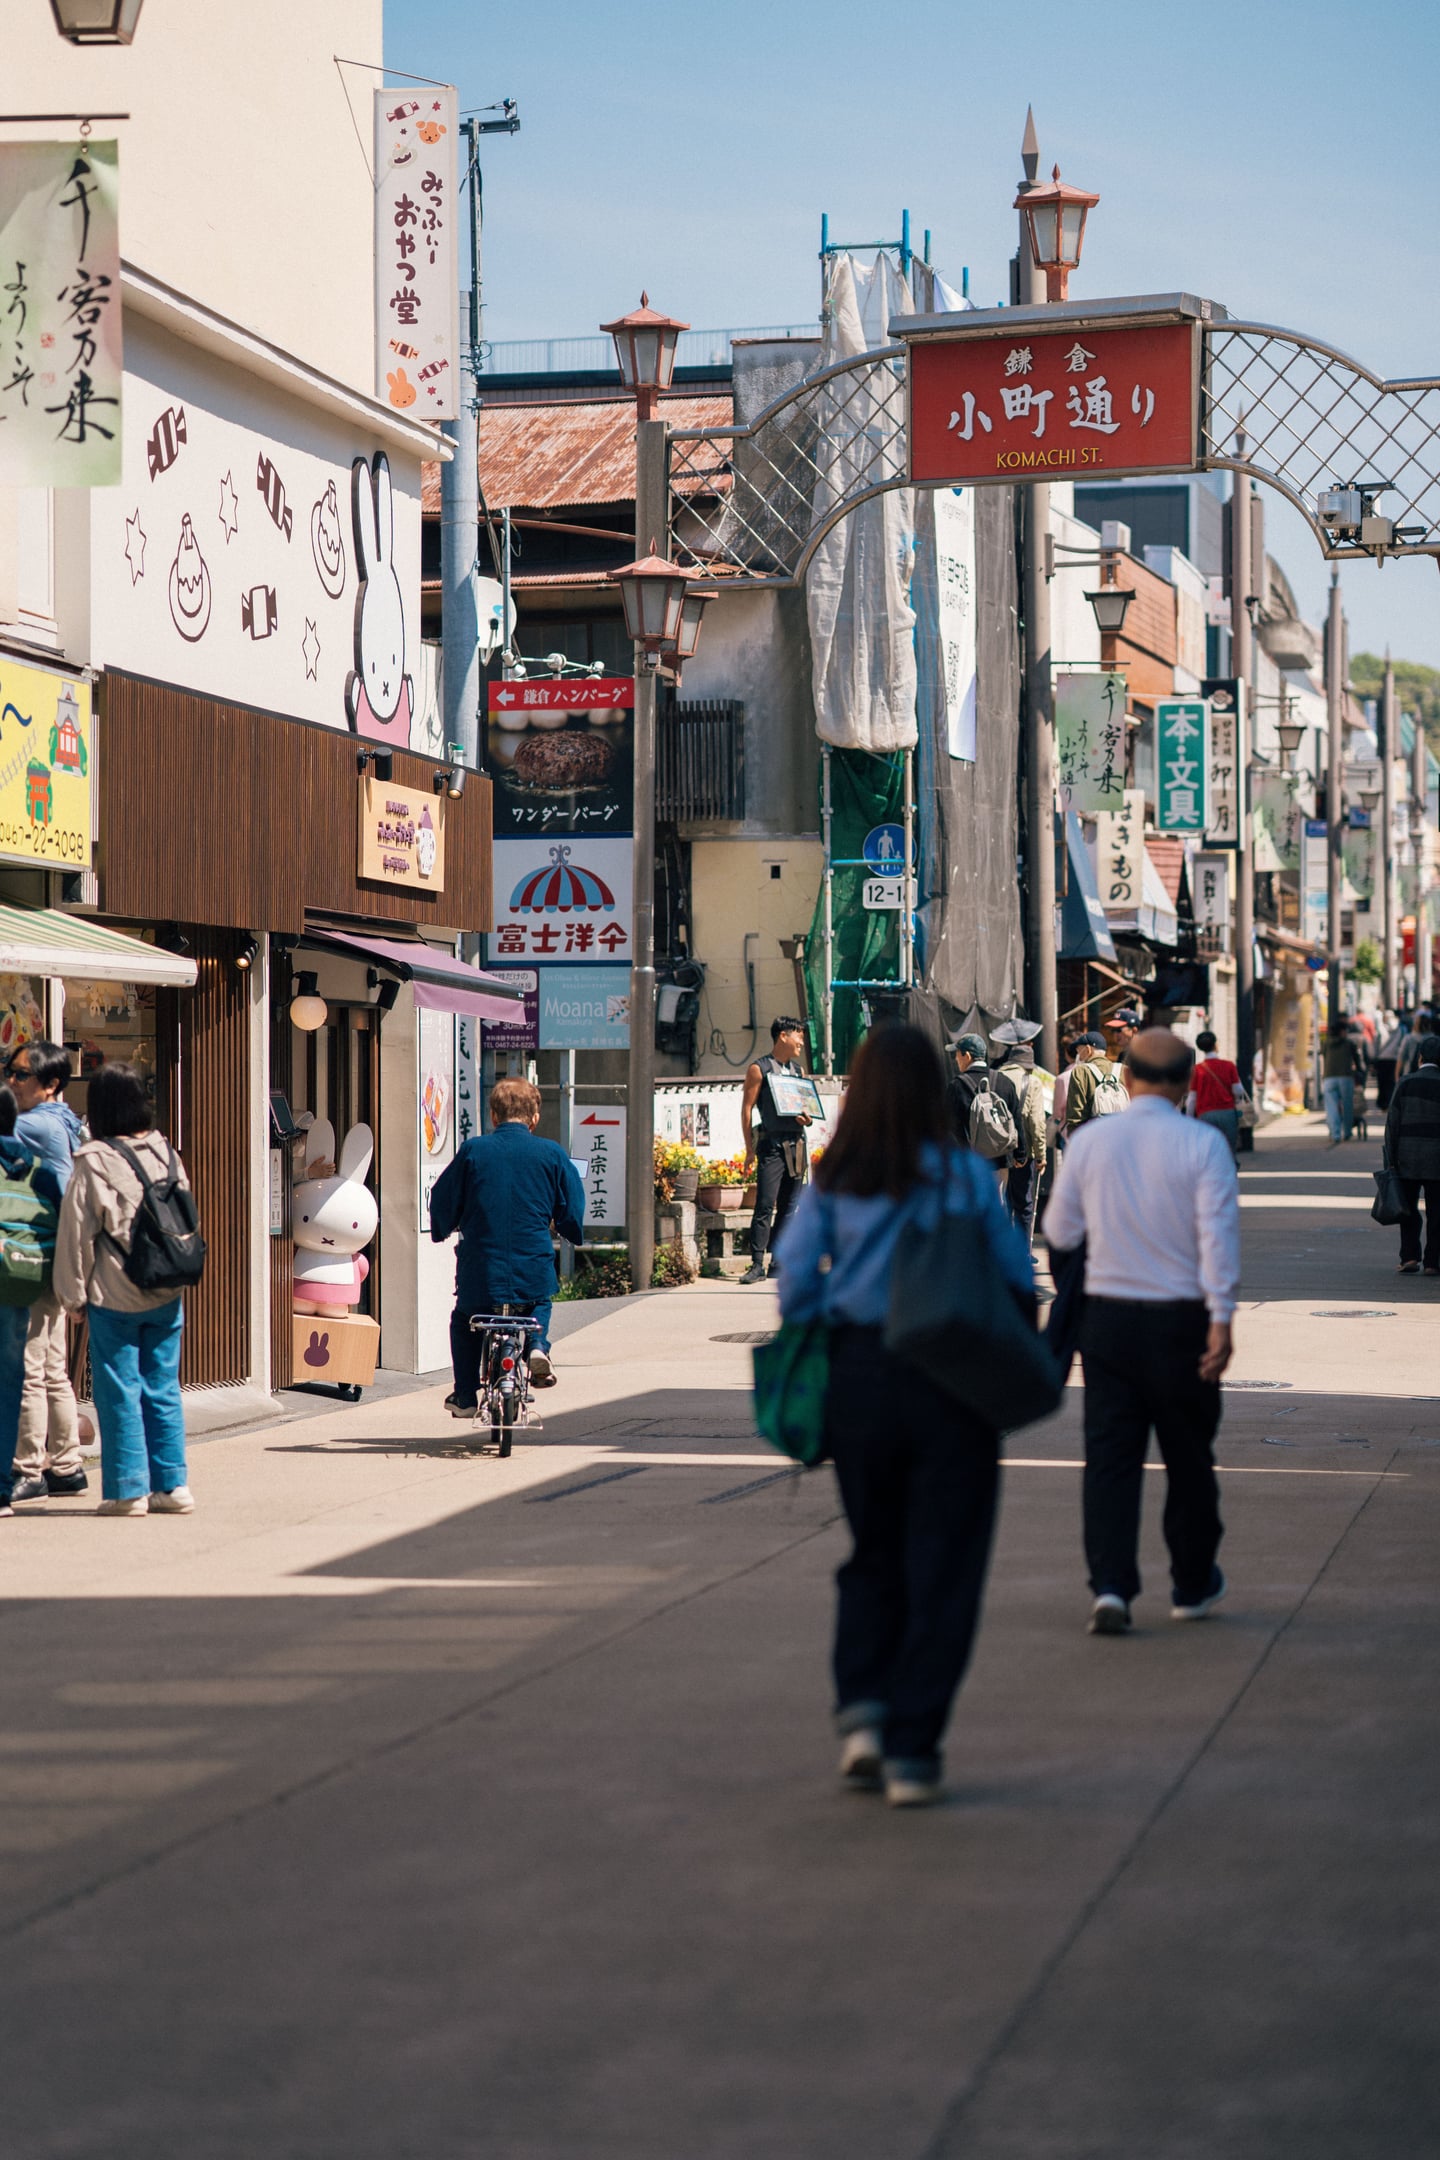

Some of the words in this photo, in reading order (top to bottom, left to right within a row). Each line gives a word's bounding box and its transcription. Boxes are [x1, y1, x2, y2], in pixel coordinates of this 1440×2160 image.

[421, 171, 444, 264] みっふぃー
[389, 194, 421, 325] おやつ堂
[3, 261, 35, 405] ようこそ
[46, 158, 118, 443] 千客万来
[947, 376, 1155, 440] 小町通り
[996, 449, 1075, 468] KOMACHI
[1080, 447, 1103, 464] ST.
[1060, 736, 1078, 803] 小町通り
[1164, 707, 1199, 825] 本・文具
[512, 804, 619, 823] ワンダーバーグ
[868, 885, 913, 902] 12-1
[545, 997, 604, 1017] Moana
[590, 1134, 608, 1219] 正宗工芸
